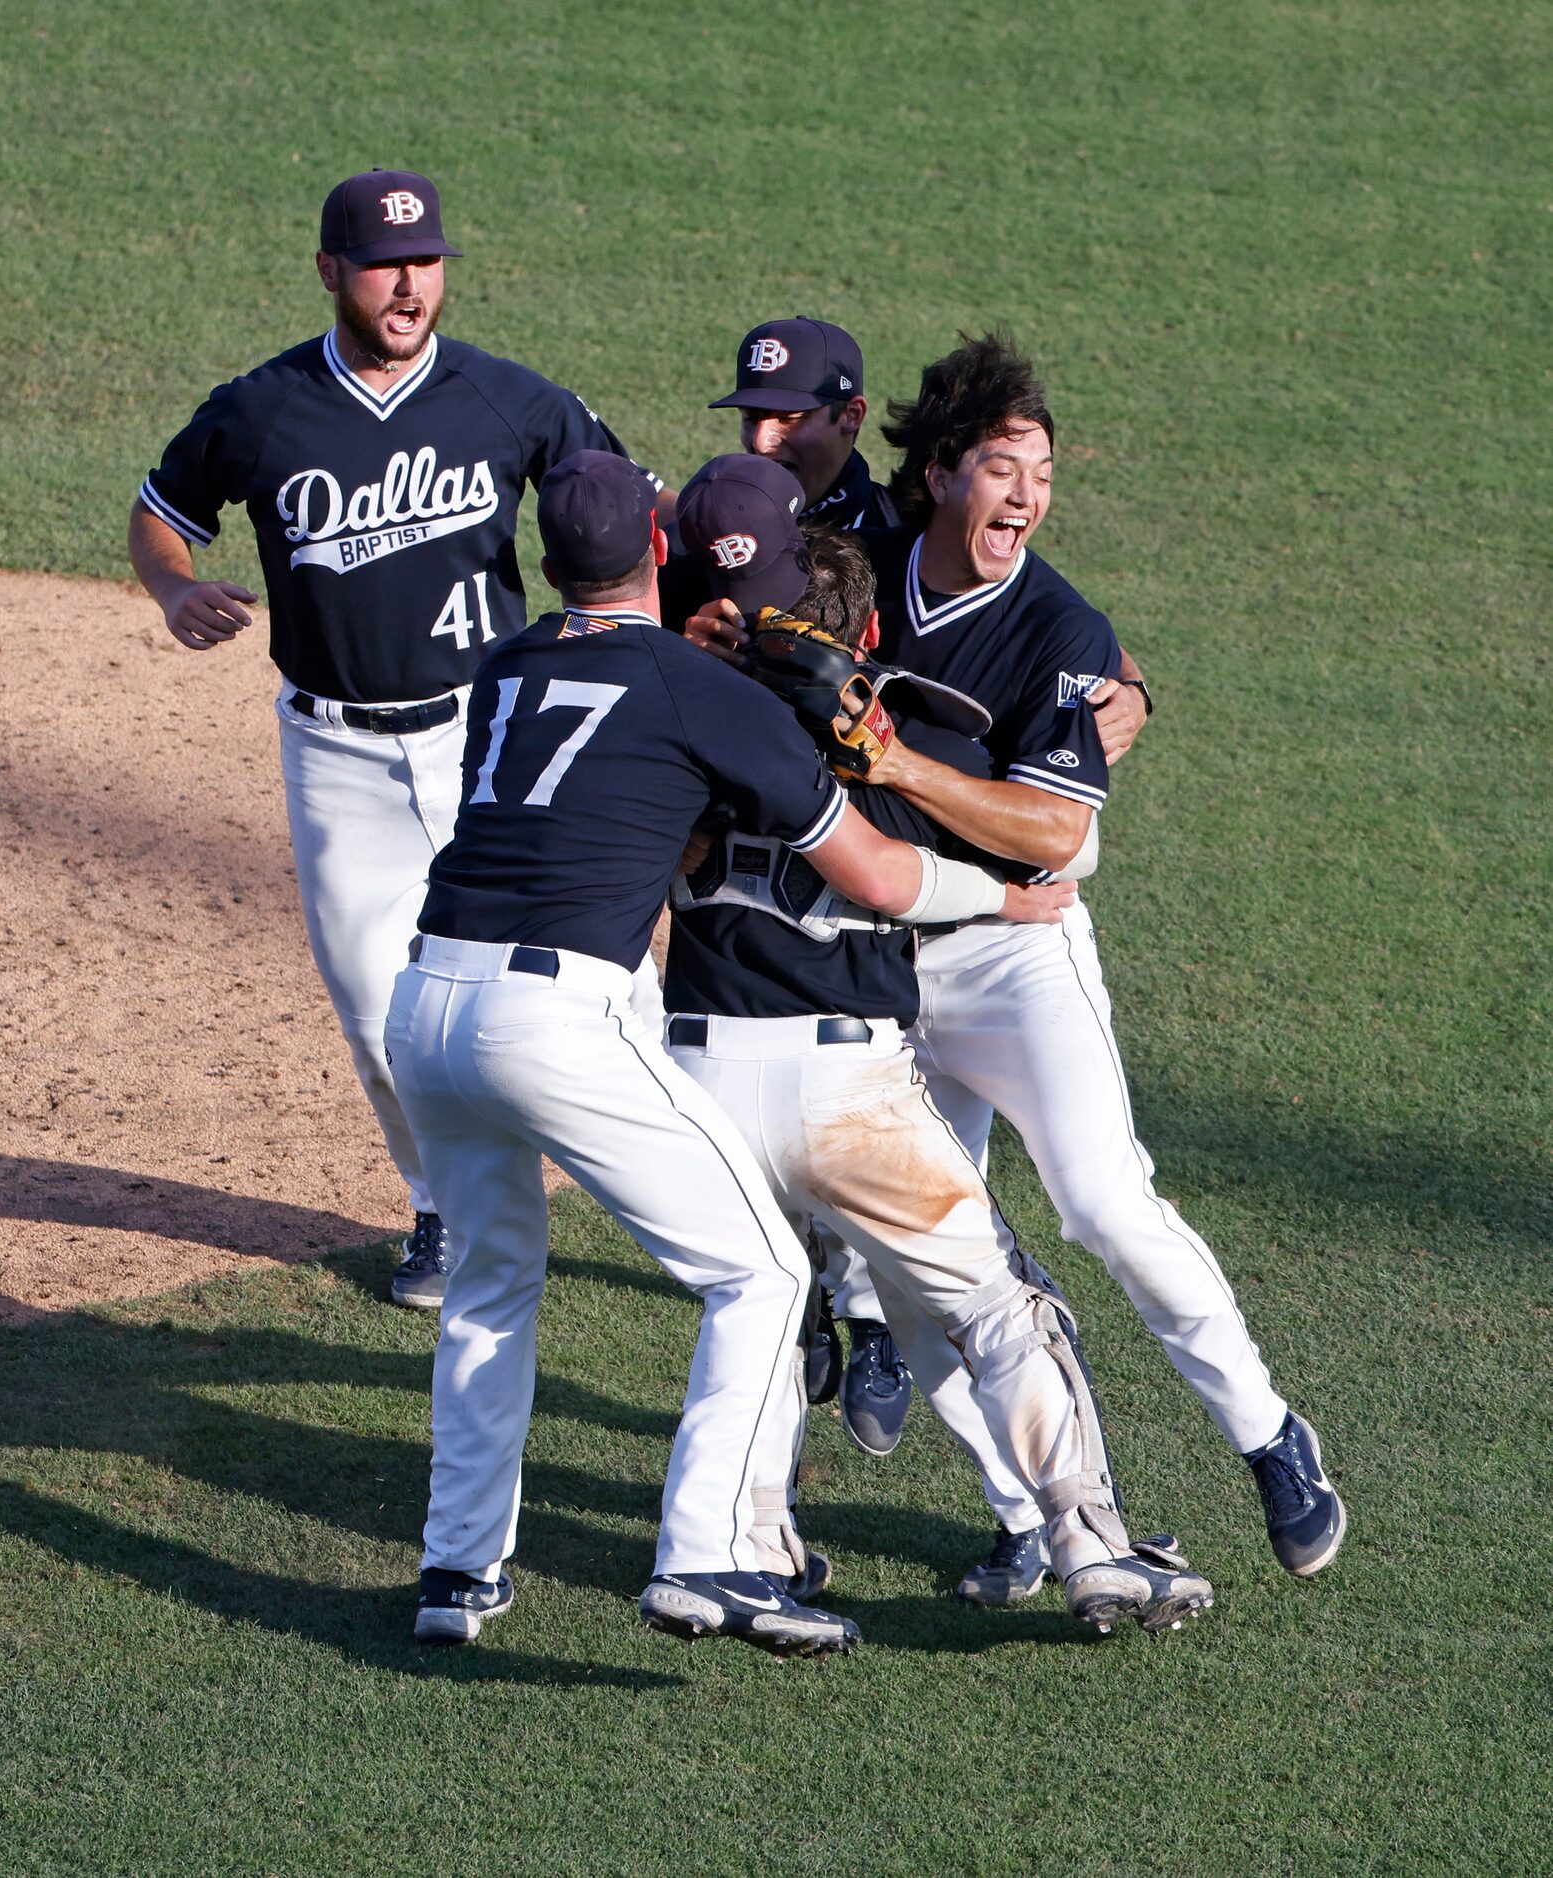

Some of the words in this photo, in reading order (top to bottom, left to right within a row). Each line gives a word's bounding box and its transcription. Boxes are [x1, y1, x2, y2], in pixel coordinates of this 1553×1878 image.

[277, 446, 496, 541] Dallas
[339, 525, 431, 567] BAPTIST
[430, 571, 497, 650] 41
[469, 677, 628, 807] 17
